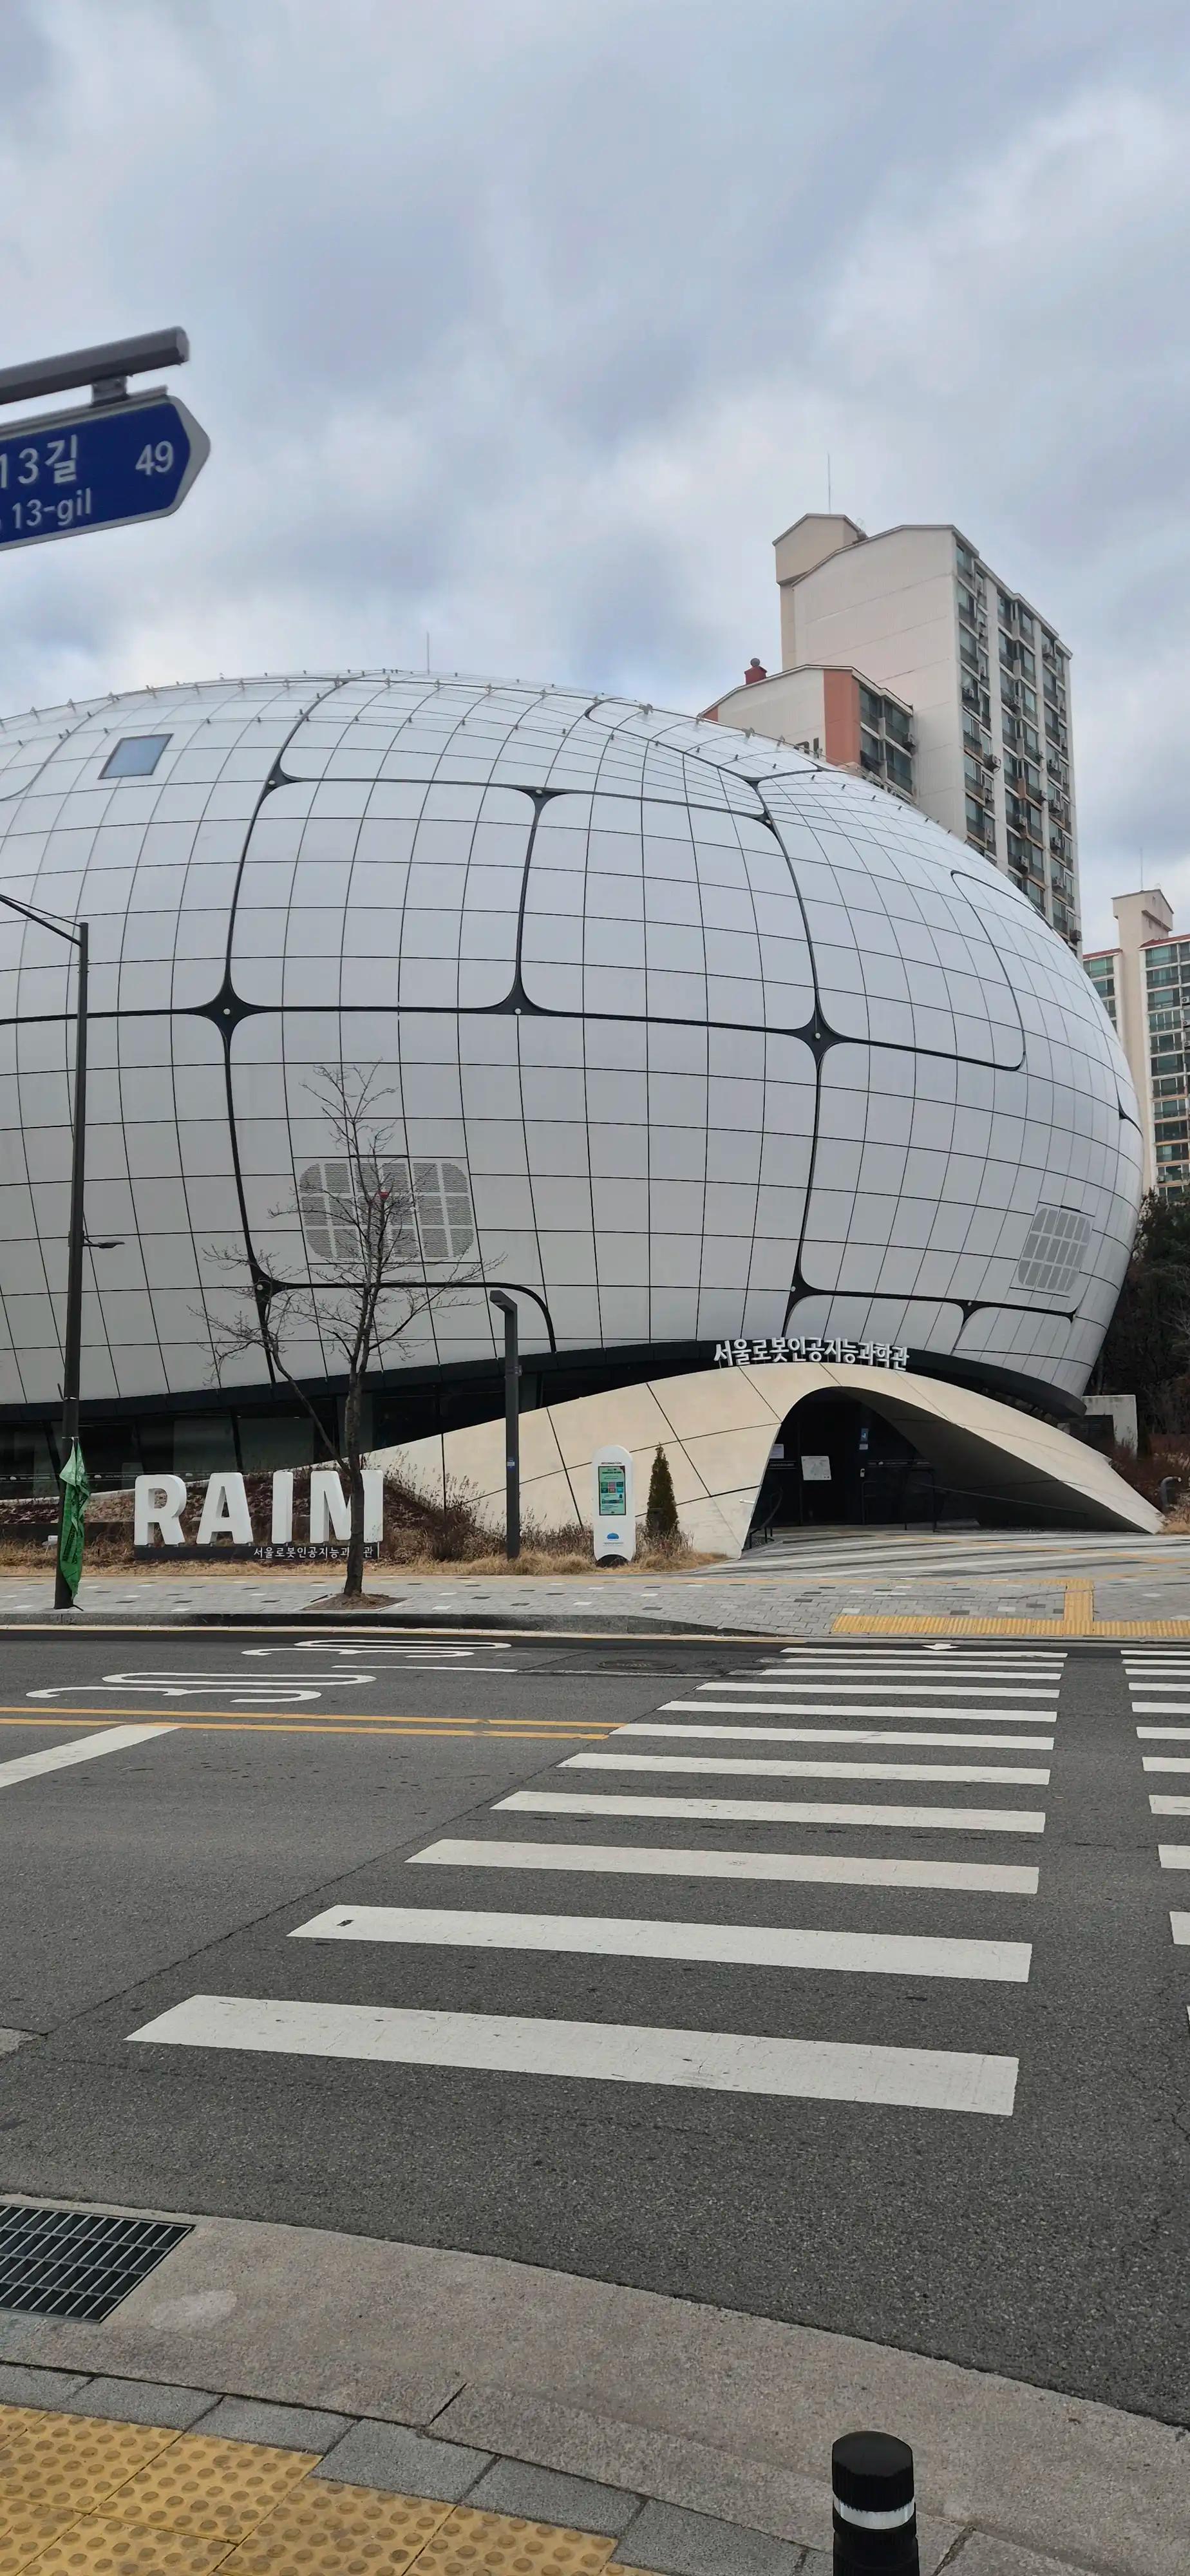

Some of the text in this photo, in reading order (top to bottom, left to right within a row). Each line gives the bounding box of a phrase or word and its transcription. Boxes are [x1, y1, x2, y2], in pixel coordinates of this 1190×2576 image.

[135, 440, 174, 475] 49
[12, 487, 91, 530] 13-gil
[713, 1336, 910, 1371] 서울로봇인공지능과학관
[134, 1470, 383, 1546] RAIM
[254, 1546, 373, 1559] 서울로봇인공지능과관
